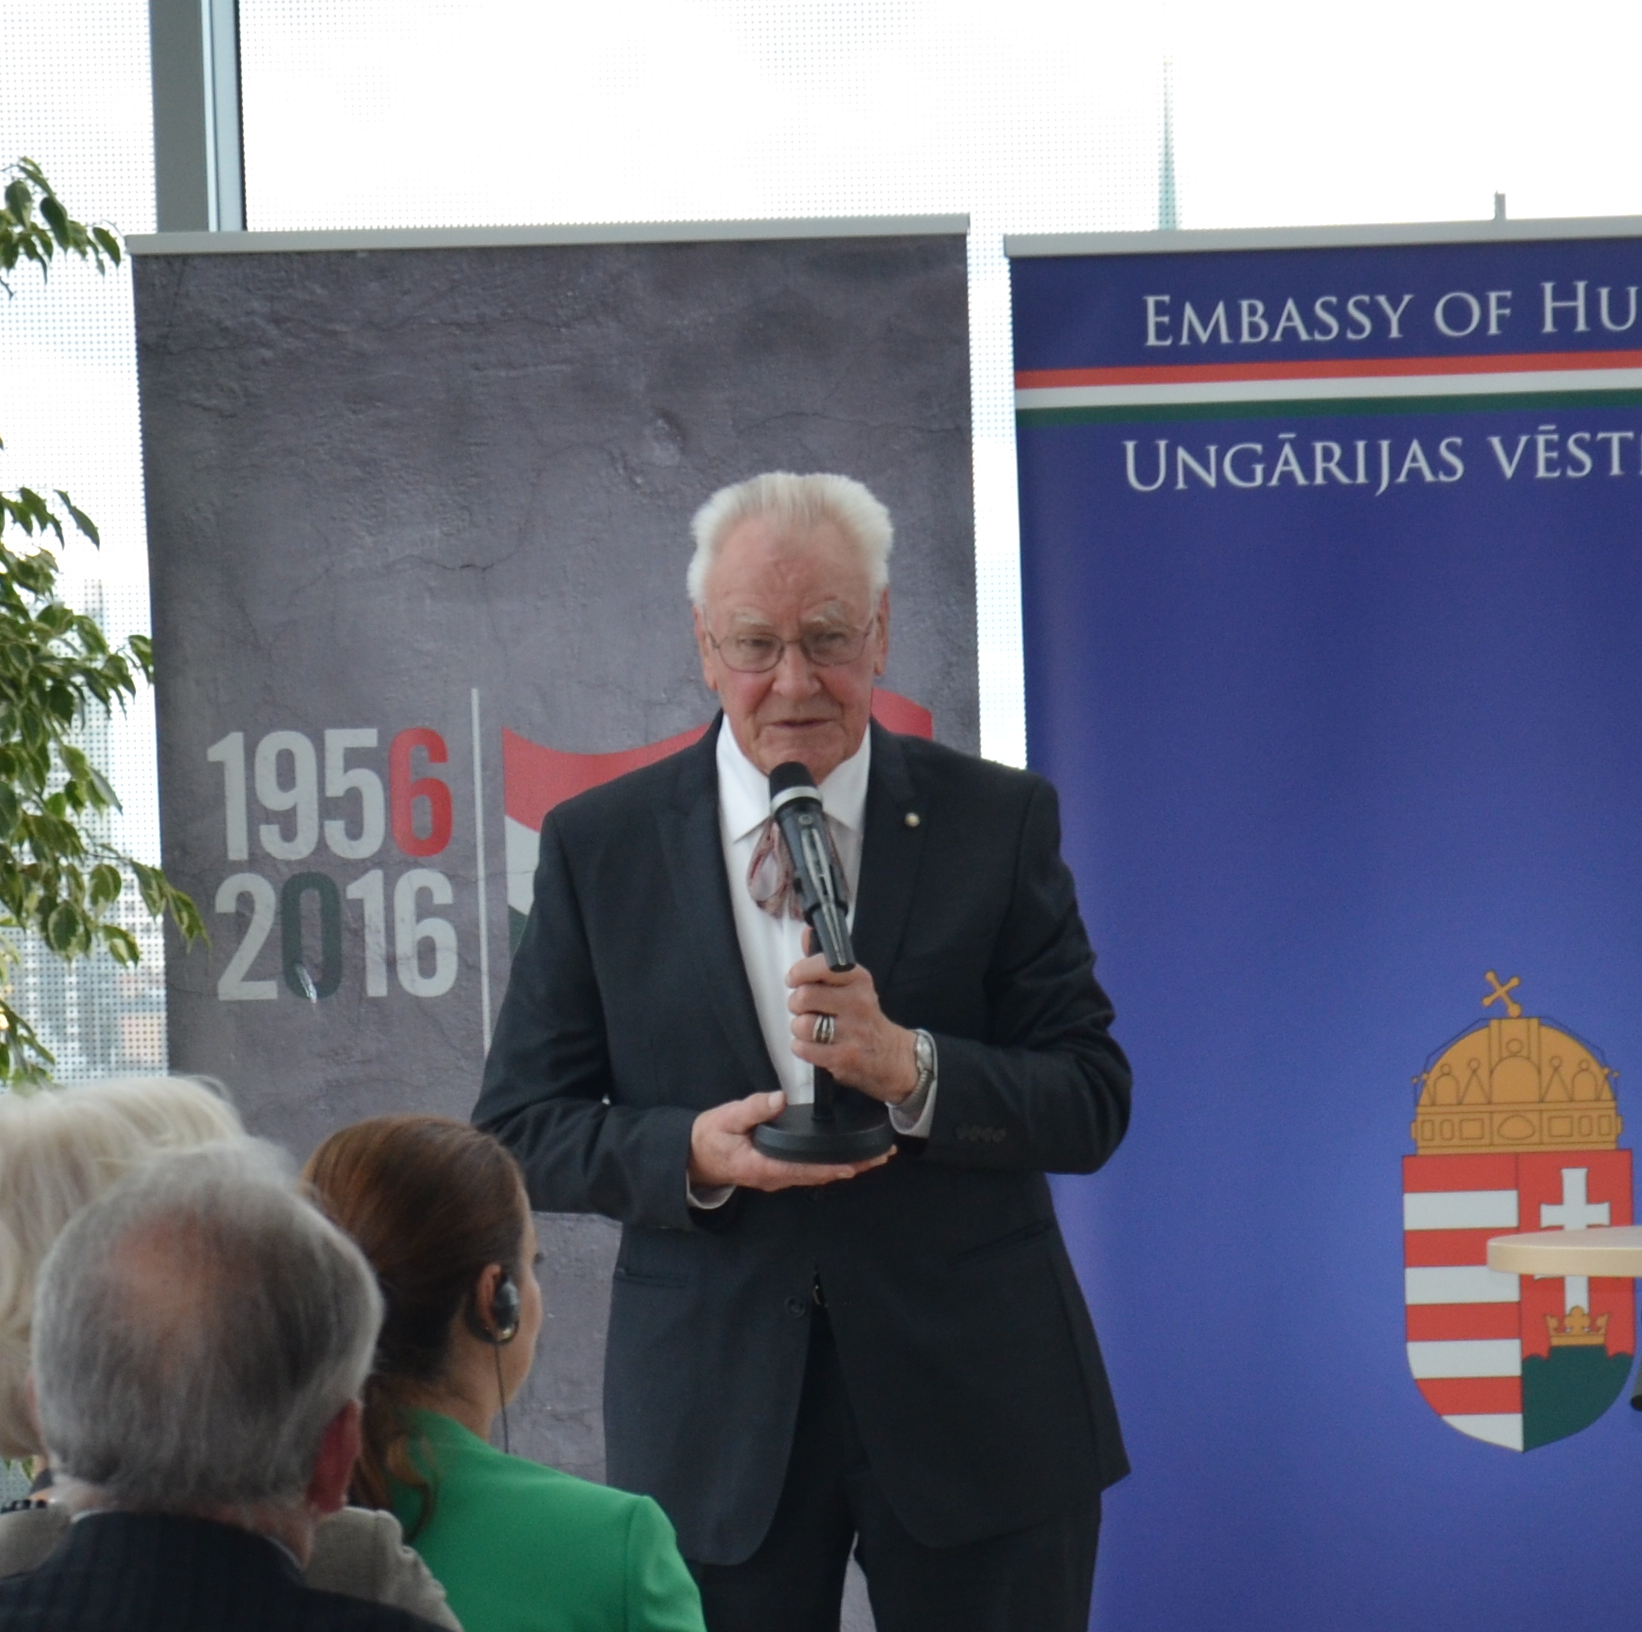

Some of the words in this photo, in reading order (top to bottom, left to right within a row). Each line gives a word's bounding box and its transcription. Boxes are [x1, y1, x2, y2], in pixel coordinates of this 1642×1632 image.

[1143, 290, 1416, 348] EMBASSY
[1433, 288, 1514, 338] OF
[1122, 431, 1466, 497] UNGĀRIJAS
[207, 726, 454, 863] 1956
[214, 866, 459, 1003] 2016
